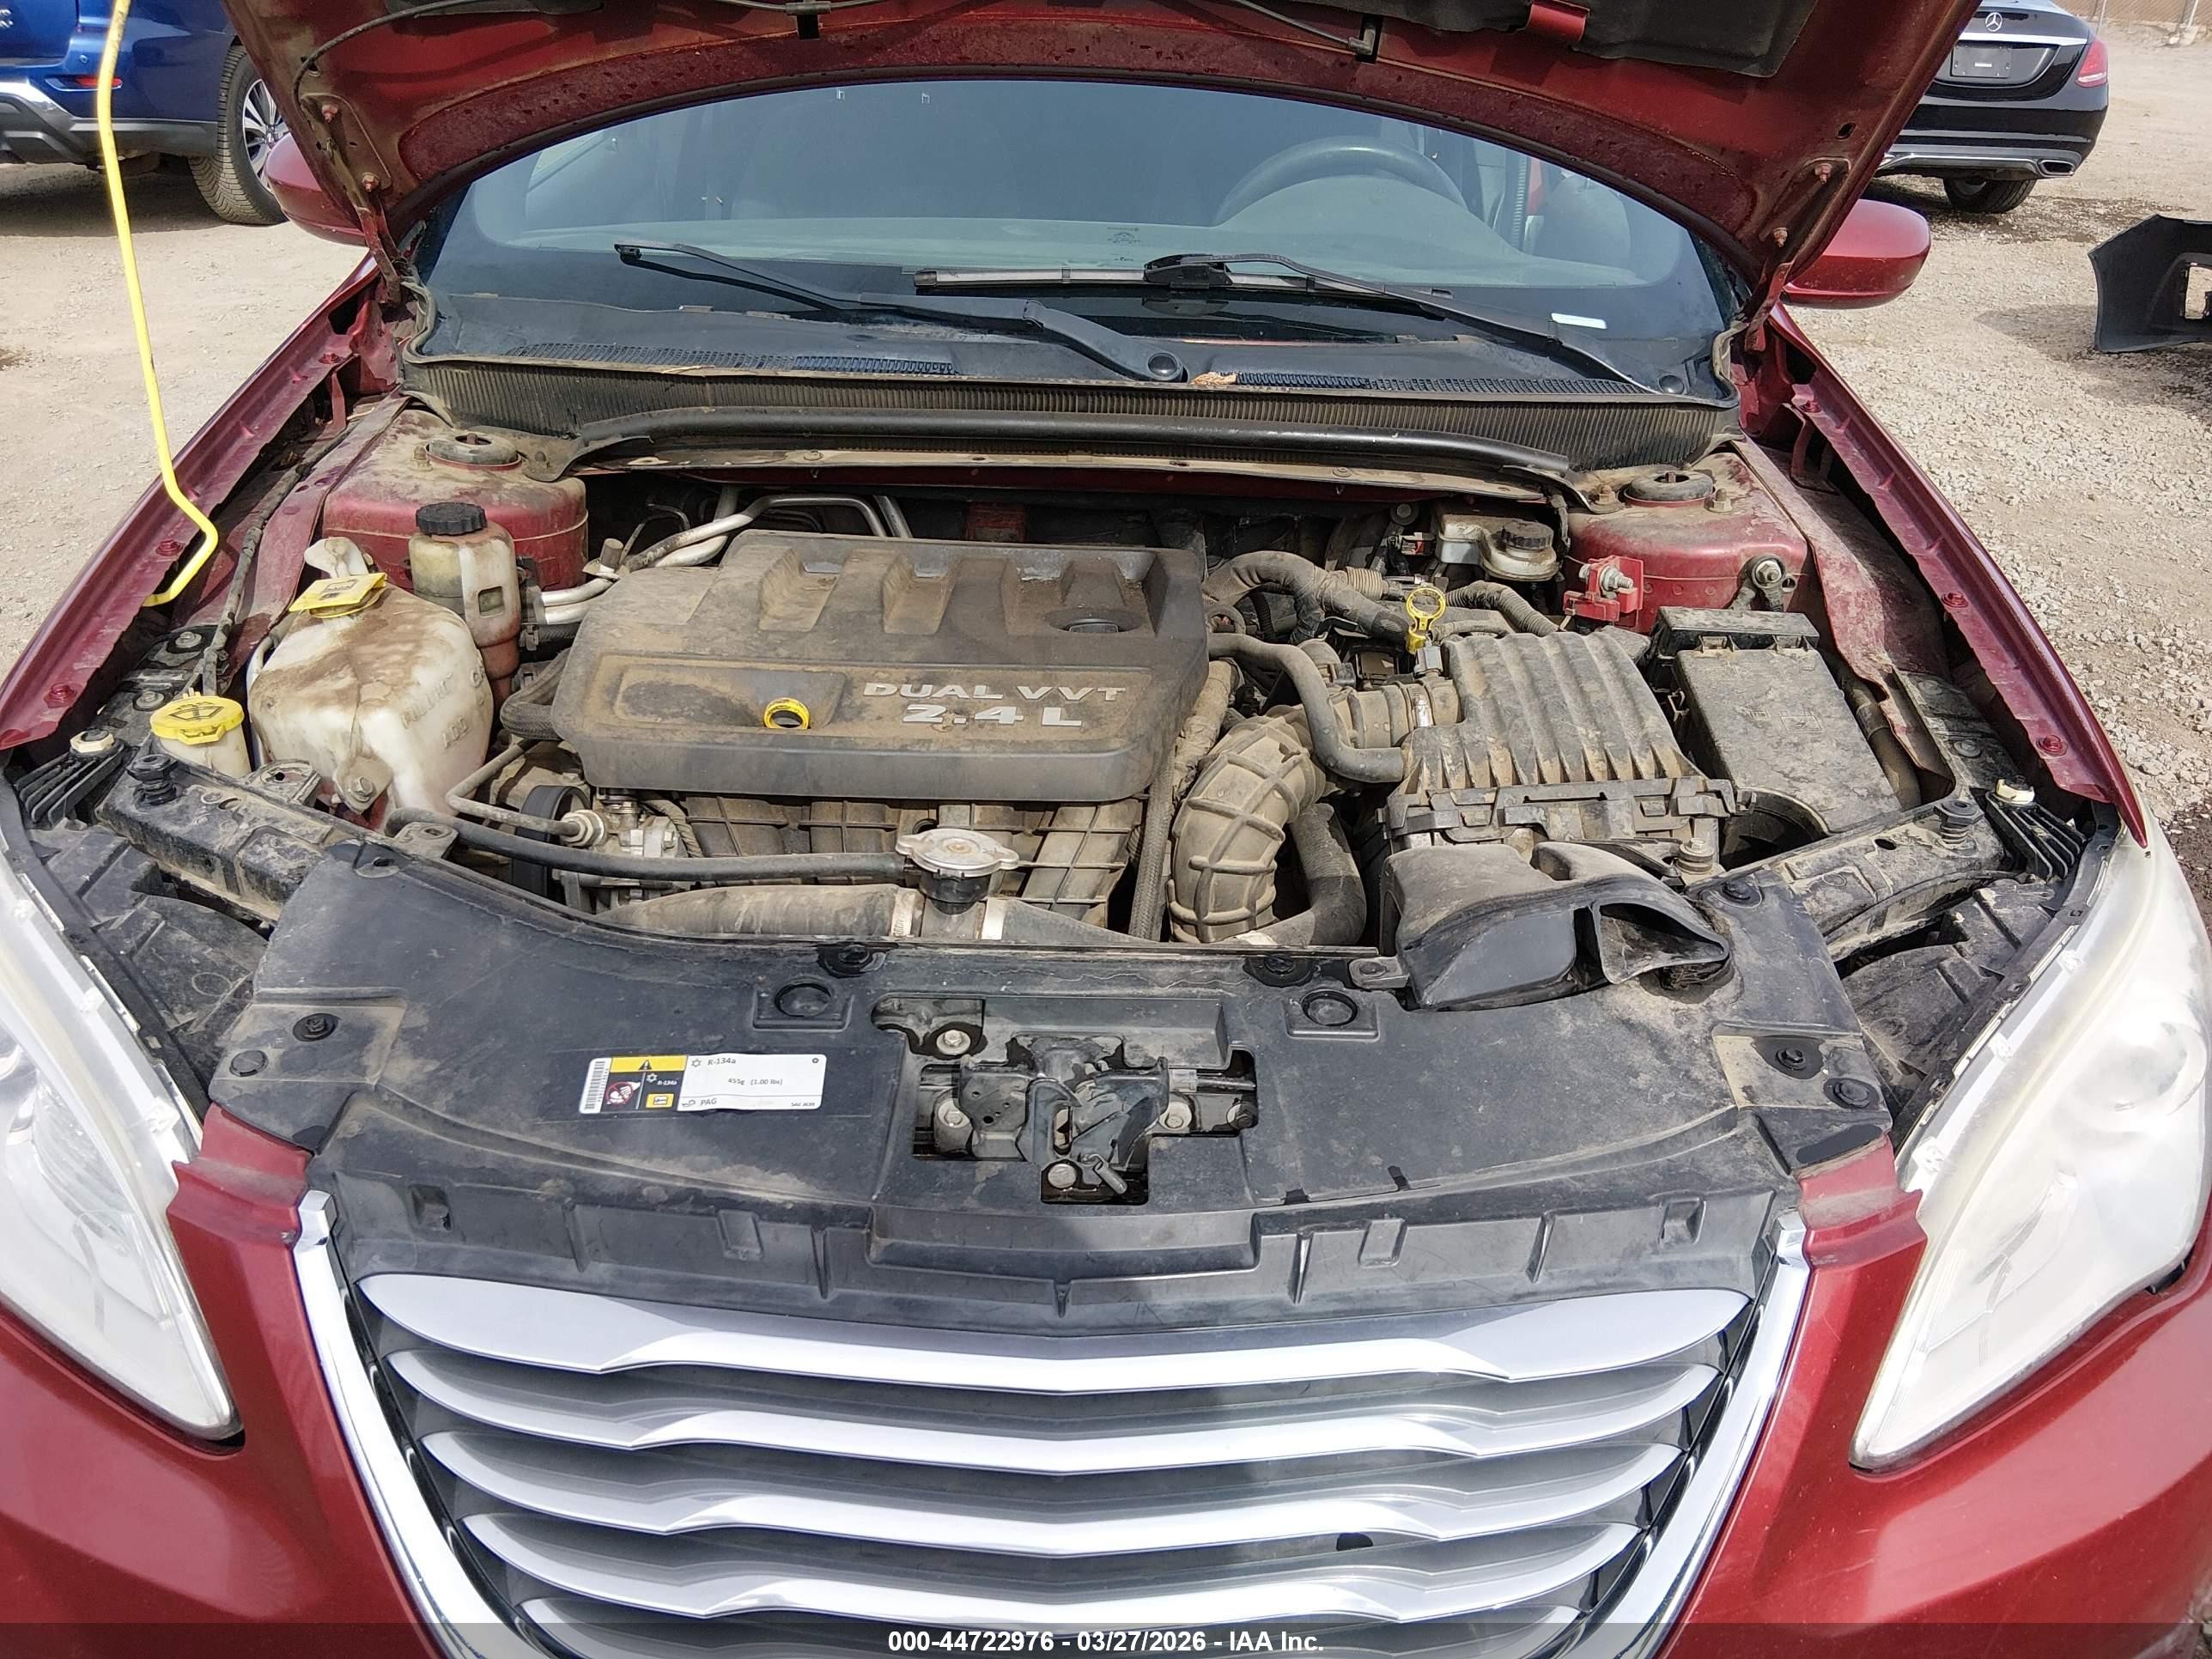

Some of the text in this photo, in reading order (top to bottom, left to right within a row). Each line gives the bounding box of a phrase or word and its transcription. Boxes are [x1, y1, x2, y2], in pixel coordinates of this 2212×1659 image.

[863, 683, 1127, 702] DUAL VVT
[902, 704, 1083, 727] 2.4 L
[708, 1057, 737, 1066] R-134a
[700, 1097, 718, 1106] PAG
